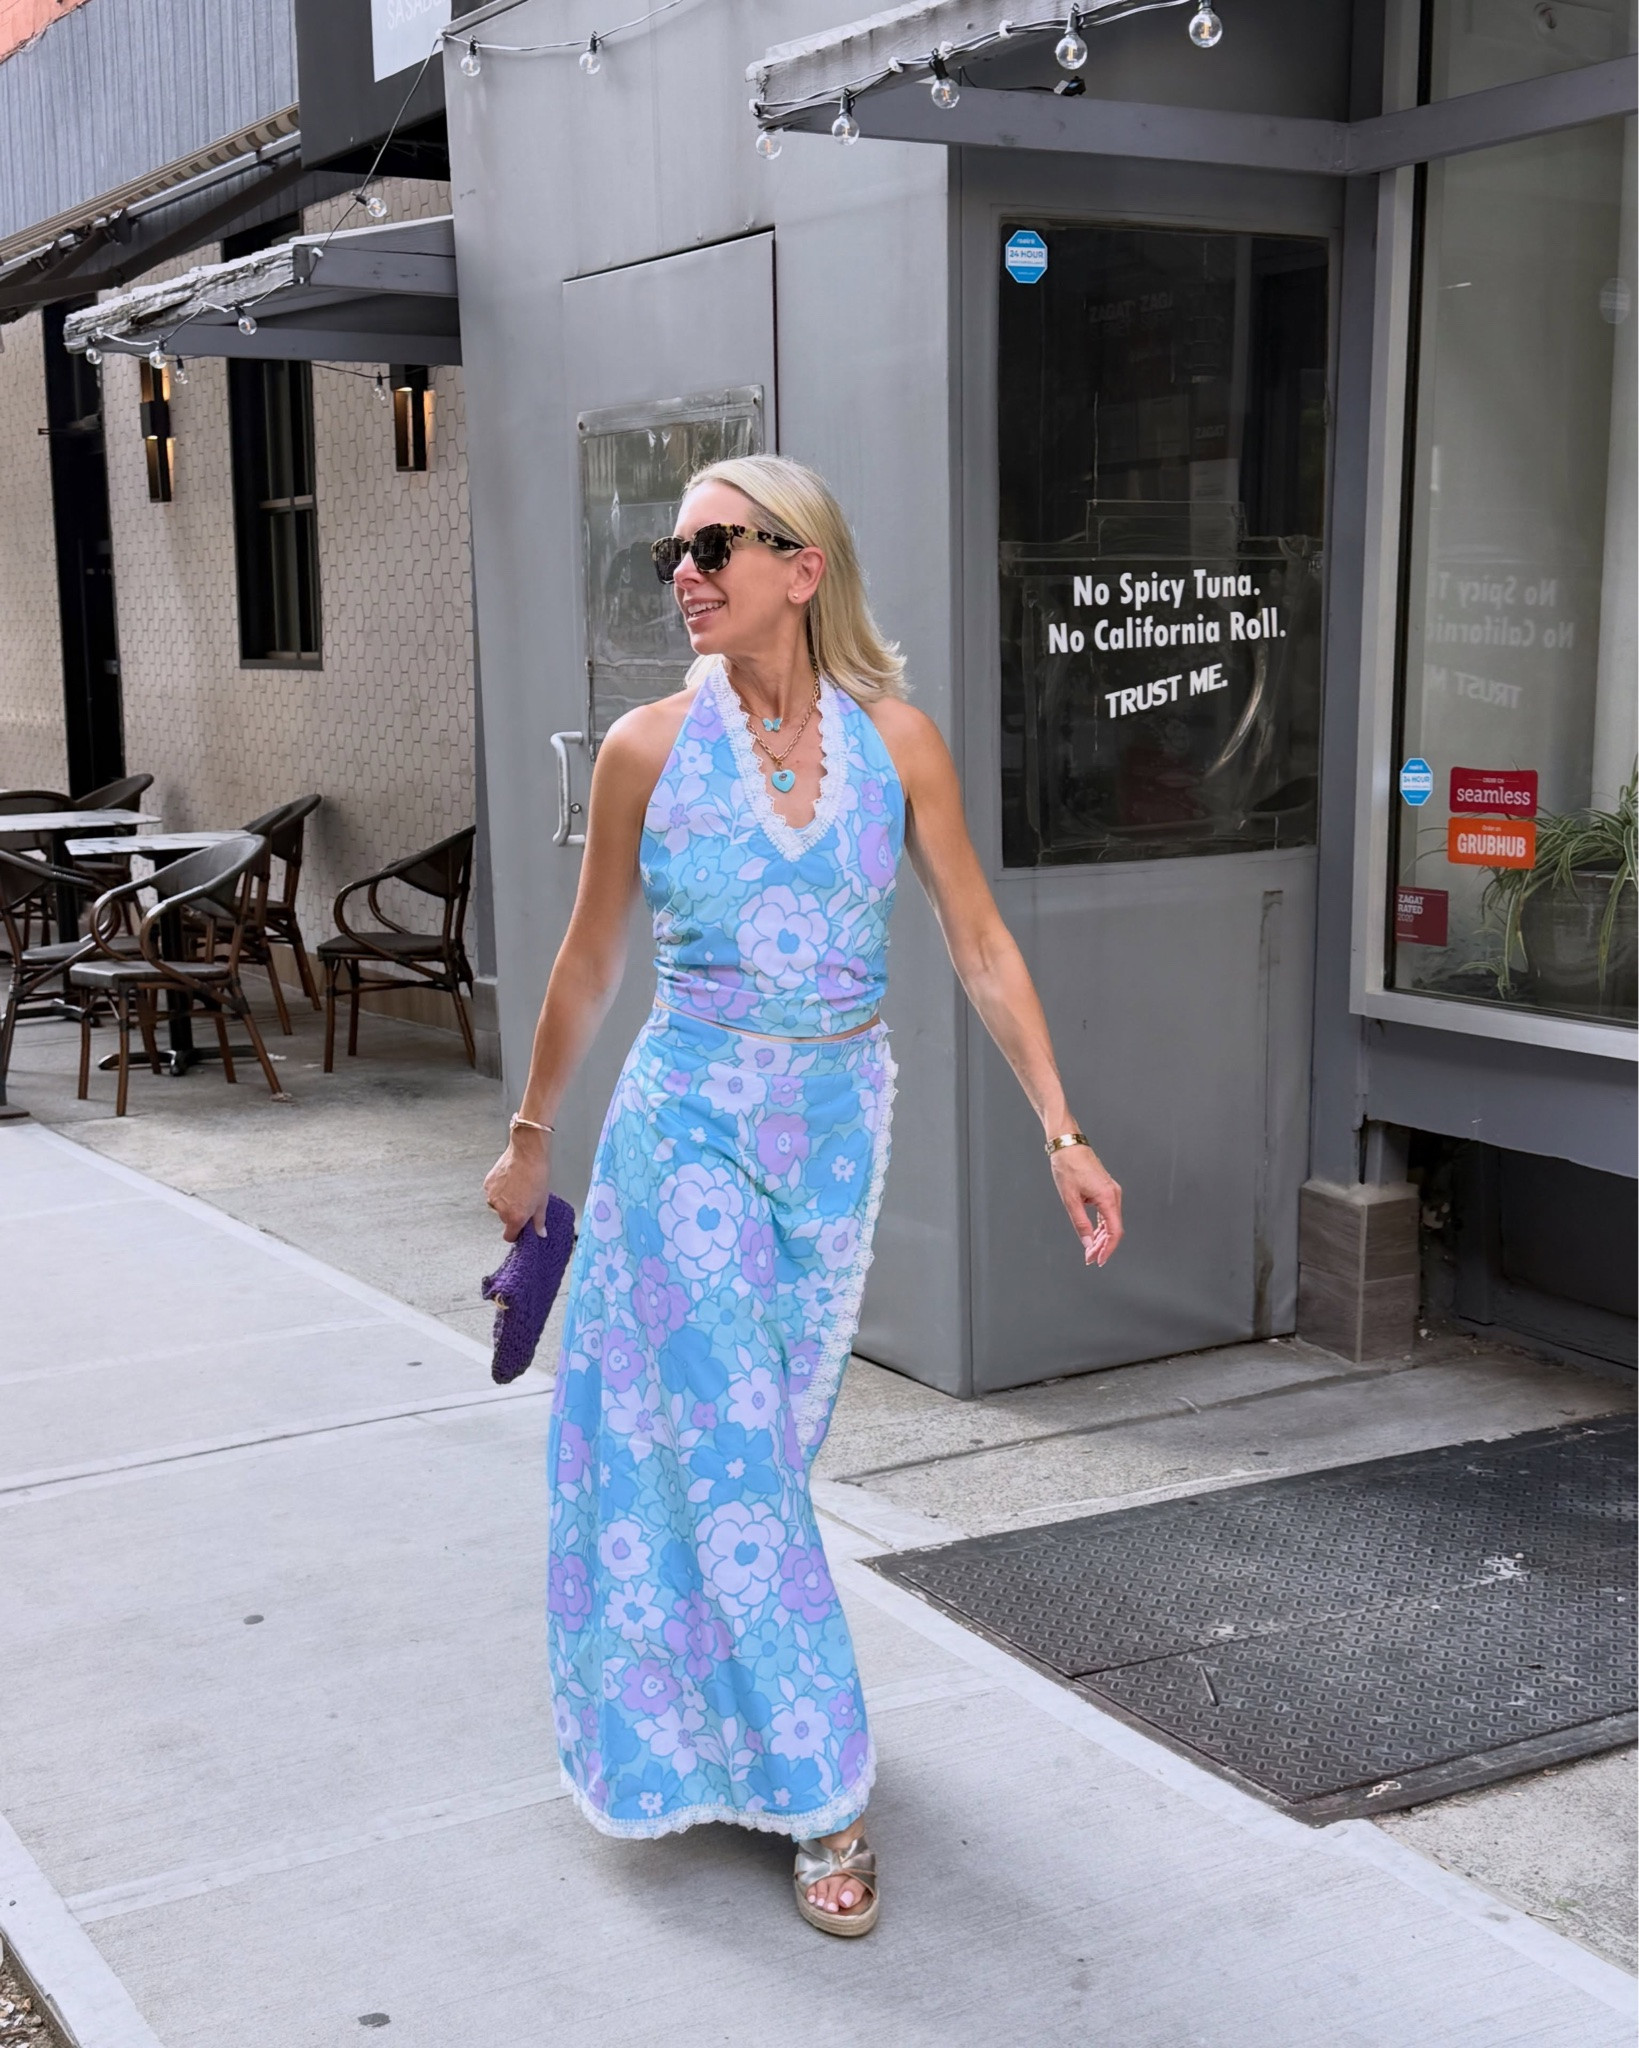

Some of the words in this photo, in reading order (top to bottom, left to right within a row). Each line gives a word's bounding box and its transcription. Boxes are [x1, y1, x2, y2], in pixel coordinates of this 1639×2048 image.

[1009, 249, 1020, 258] 24
[1020, 250, 1044, 259] HOUR
[1073, 575, 1110, 607] No
[1119, 572, 1185, 611] Spicy
[1193, 568, 1261, 599] Tuna.
[1048, 622, 1085, 654] No
[1094, 613, 1220, 651] California
[1230, 607, 1287, 641] Roll.
[1104, 674, 1182, 719] TRUST
[1189, 662, 1228, 697] ME.
[1456, 786, 1531, 806] seamless
[1457, 833, 1526, 858] GRUBHUB
[1398, 894, 1424, 905] ZAGAT
[1398, 904, 1424, 915] RATED
